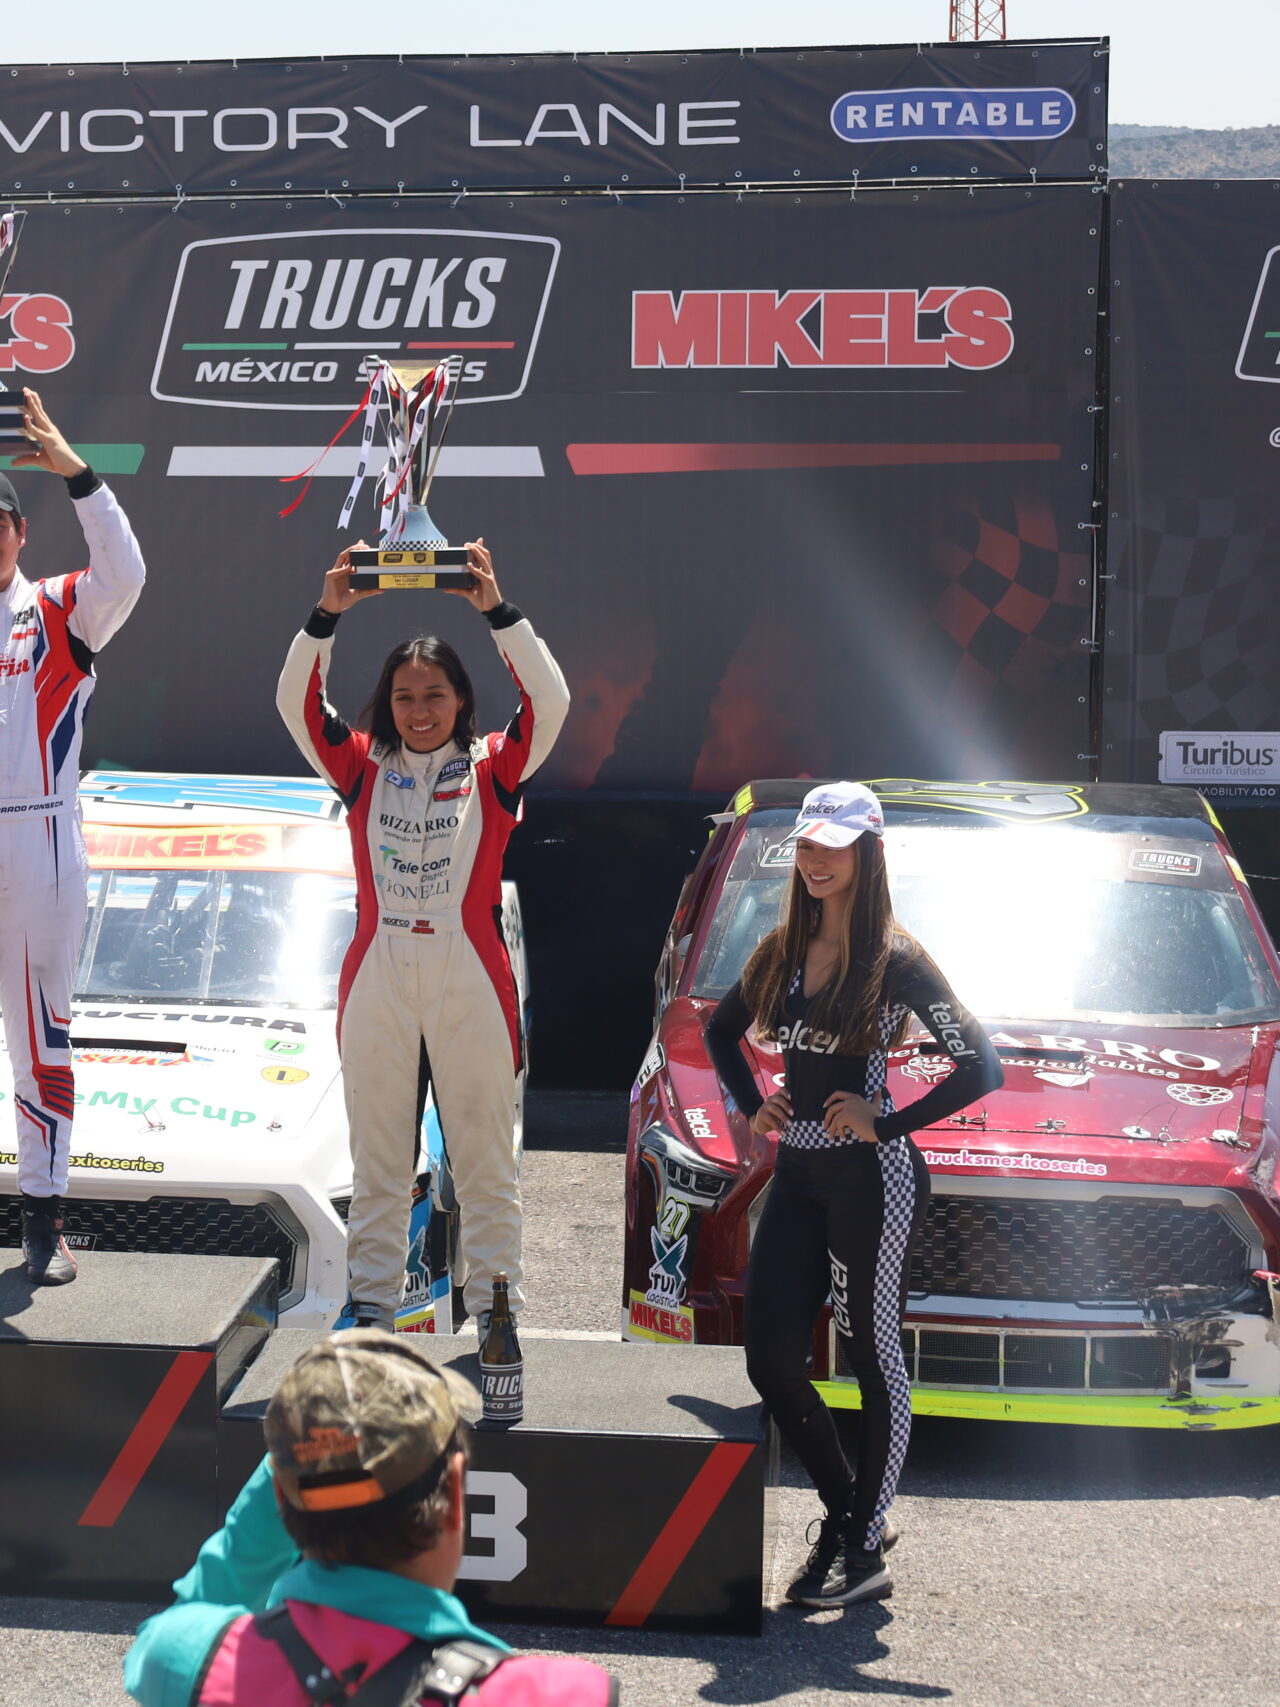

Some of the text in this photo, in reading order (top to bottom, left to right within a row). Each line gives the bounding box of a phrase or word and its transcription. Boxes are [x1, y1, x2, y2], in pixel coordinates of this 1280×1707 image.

[469, 100, 741, 148] LANE
[845, 100, 1062, 129] RENTABLE
[223, 256, 508, 330] TRUCKS
[630, 285, 1015, 371] MIKEL'S
[194, 356, 340, 383] MÉXICO
[1175, 740, 1274, 767] Turibus
[1183, 765, 1223, 776] Circuito
[1196, 787, 1276, 797] MOBILITY ADO
[379, 813, 459, 834] BIZZARRO
[801, 802, 845, 816] telcel
[1141, 852, 1192, 867] TRUCKS
[928, 1002, 977, 1058] telcel
[170, 1096, 258, 1128] Cup
[683, 1106, 718, 1139] telcel
[923, 1149, 1109, 1177] trucksmexicoseries
[660, 1199, 690, 1241] 27
[827, 1247, 854, 1338] telcel
[629, 1300, 694, 1344] MIKEL'S
[481, 1374, 524, 1397] TRUC
[457, 1470, 528, 1582] 3
